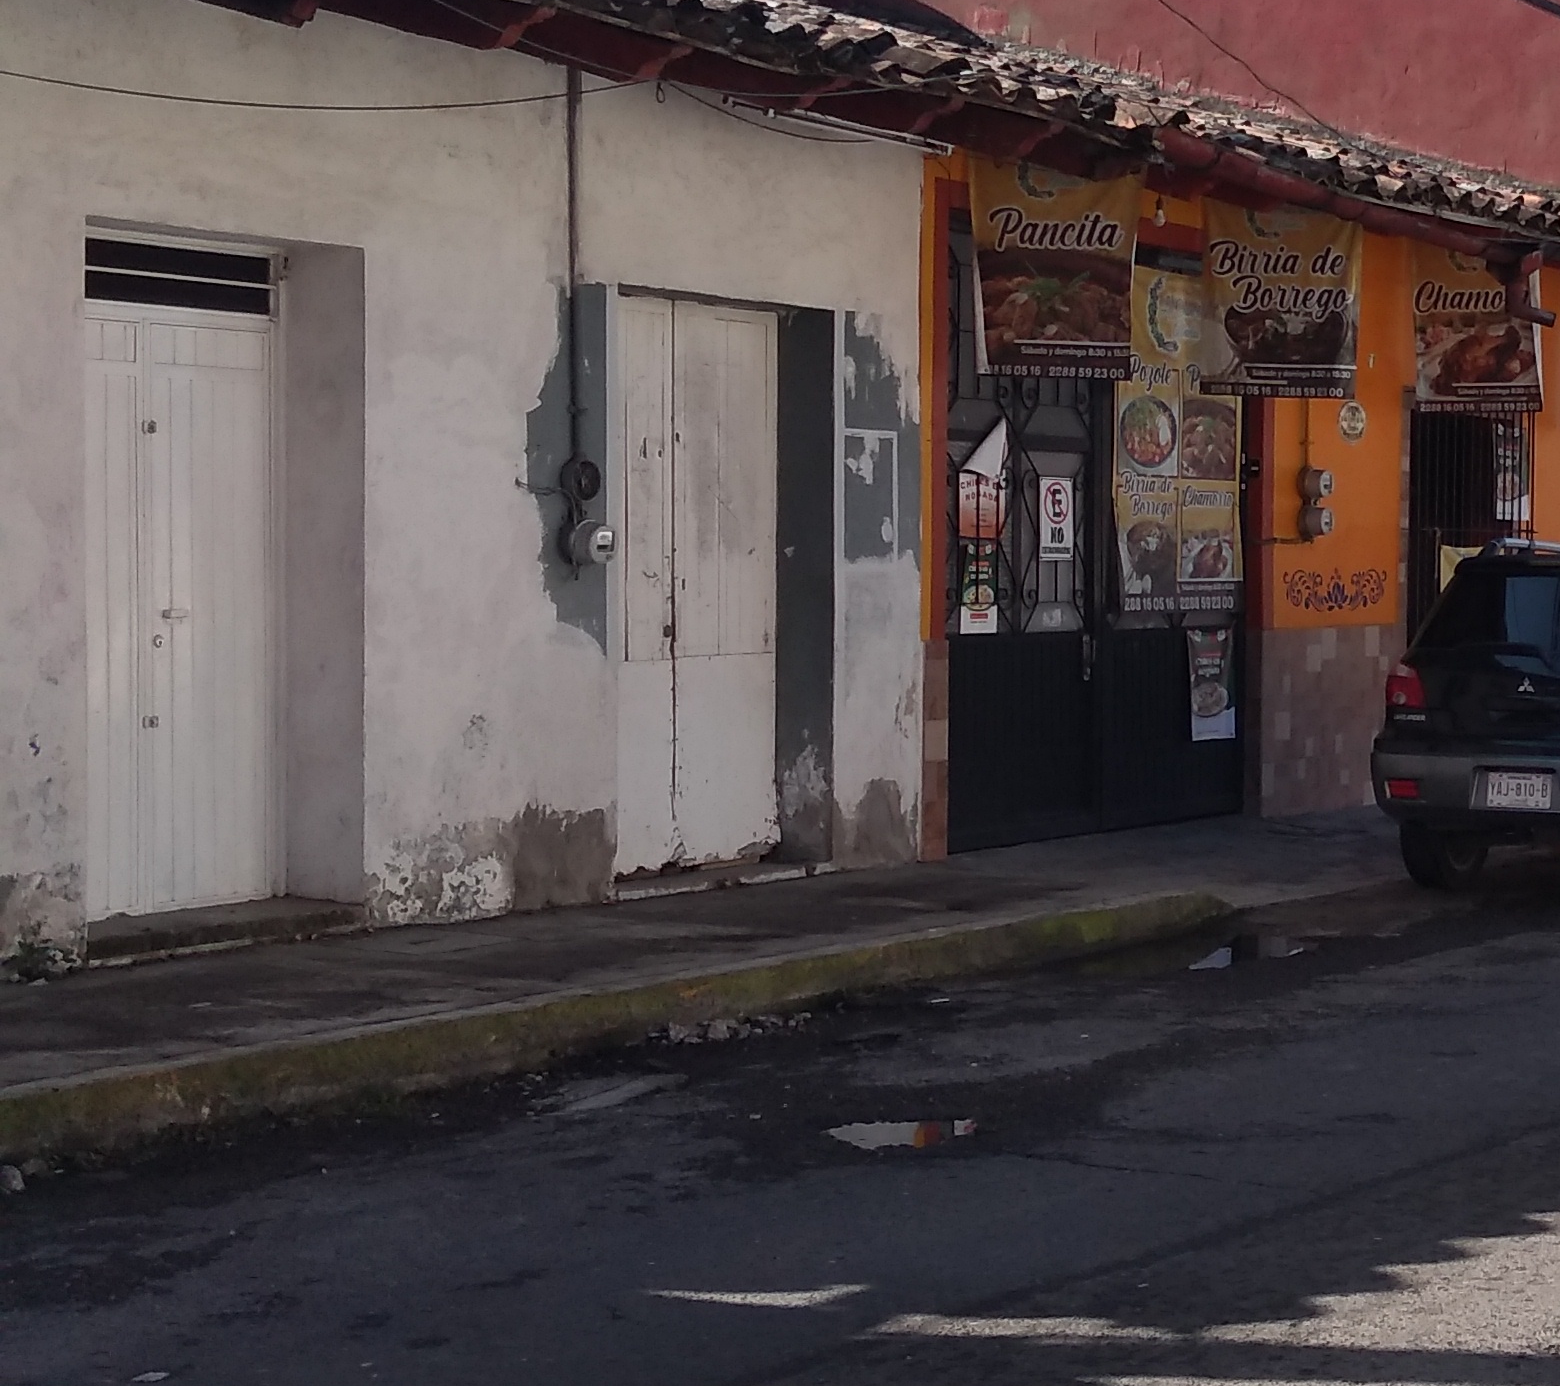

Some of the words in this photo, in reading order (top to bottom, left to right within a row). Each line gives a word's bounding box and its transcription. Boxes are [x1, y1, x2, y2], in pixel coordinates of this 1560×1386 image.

[989, 207, 1122, 250] Pancita
[1210, 240, 1300, 276] Birria
[1311, 246, 1344, 276] de
[1232, 274, 1351, 321] Borrego
[1415, 281, 1505, 313] Chamo
[1001, 365, 1012, 375] 16
[1014, 365, 1028, 376] 05
[1030, 365, 1041, 376] 16
[1048, 366, 1076, 377] 2288
[1078, 367, 1092, 377] 59
[1093, 367, 1108, 378] 23
[1109, 368, 1125, 379] 00
[1130, 354, 1172, 392] Pozole
[1246, 385, 1260, 395] 05
[1262, 386, 1272, 396] 16
[1303, 387, 1315, 397] 59
[1328, 387, 1344, 398] 00
[1504, 403, 1515, 412] 59
[1516, 402, 1528, 411] 23
[1121, 471, 1159, 494] Birria
[965, 491, 998, 502] NOADA
[1130, 494, 1174, 523] Borrego
[1050, 527, 1064, 544] NO
[1143, 597, 1152, 611] 16
[1153, 597, 1165, 611] 05
[1166, 597, 1175, 610] 16
[1201, 596, 1211, 609] 59
[1222, 595, 1234, 609] 00
[1490, 781, 1548, 798] YAJ-810-B
